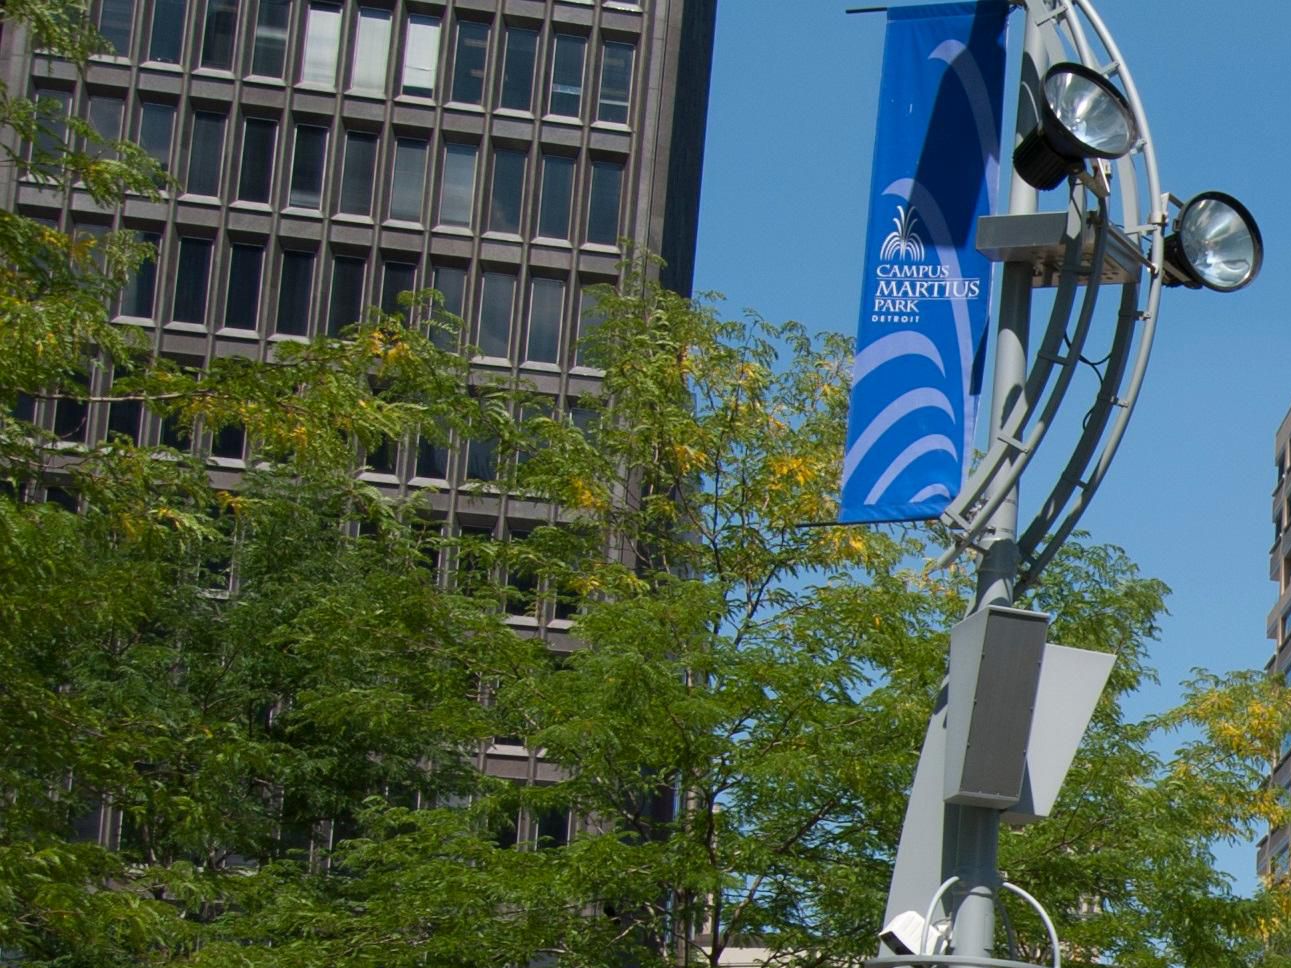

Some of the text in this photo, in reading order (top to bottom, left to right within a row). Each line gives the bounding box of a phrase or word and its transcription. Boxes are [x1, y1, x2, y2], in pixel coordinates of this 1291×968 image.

[876, 264, 950, 278] CAMPUS
[875, 280, 980, 297] MARTIUS
[873, 299, 919, 312] PARK
[871, 315, 920, 323] DETROIT
